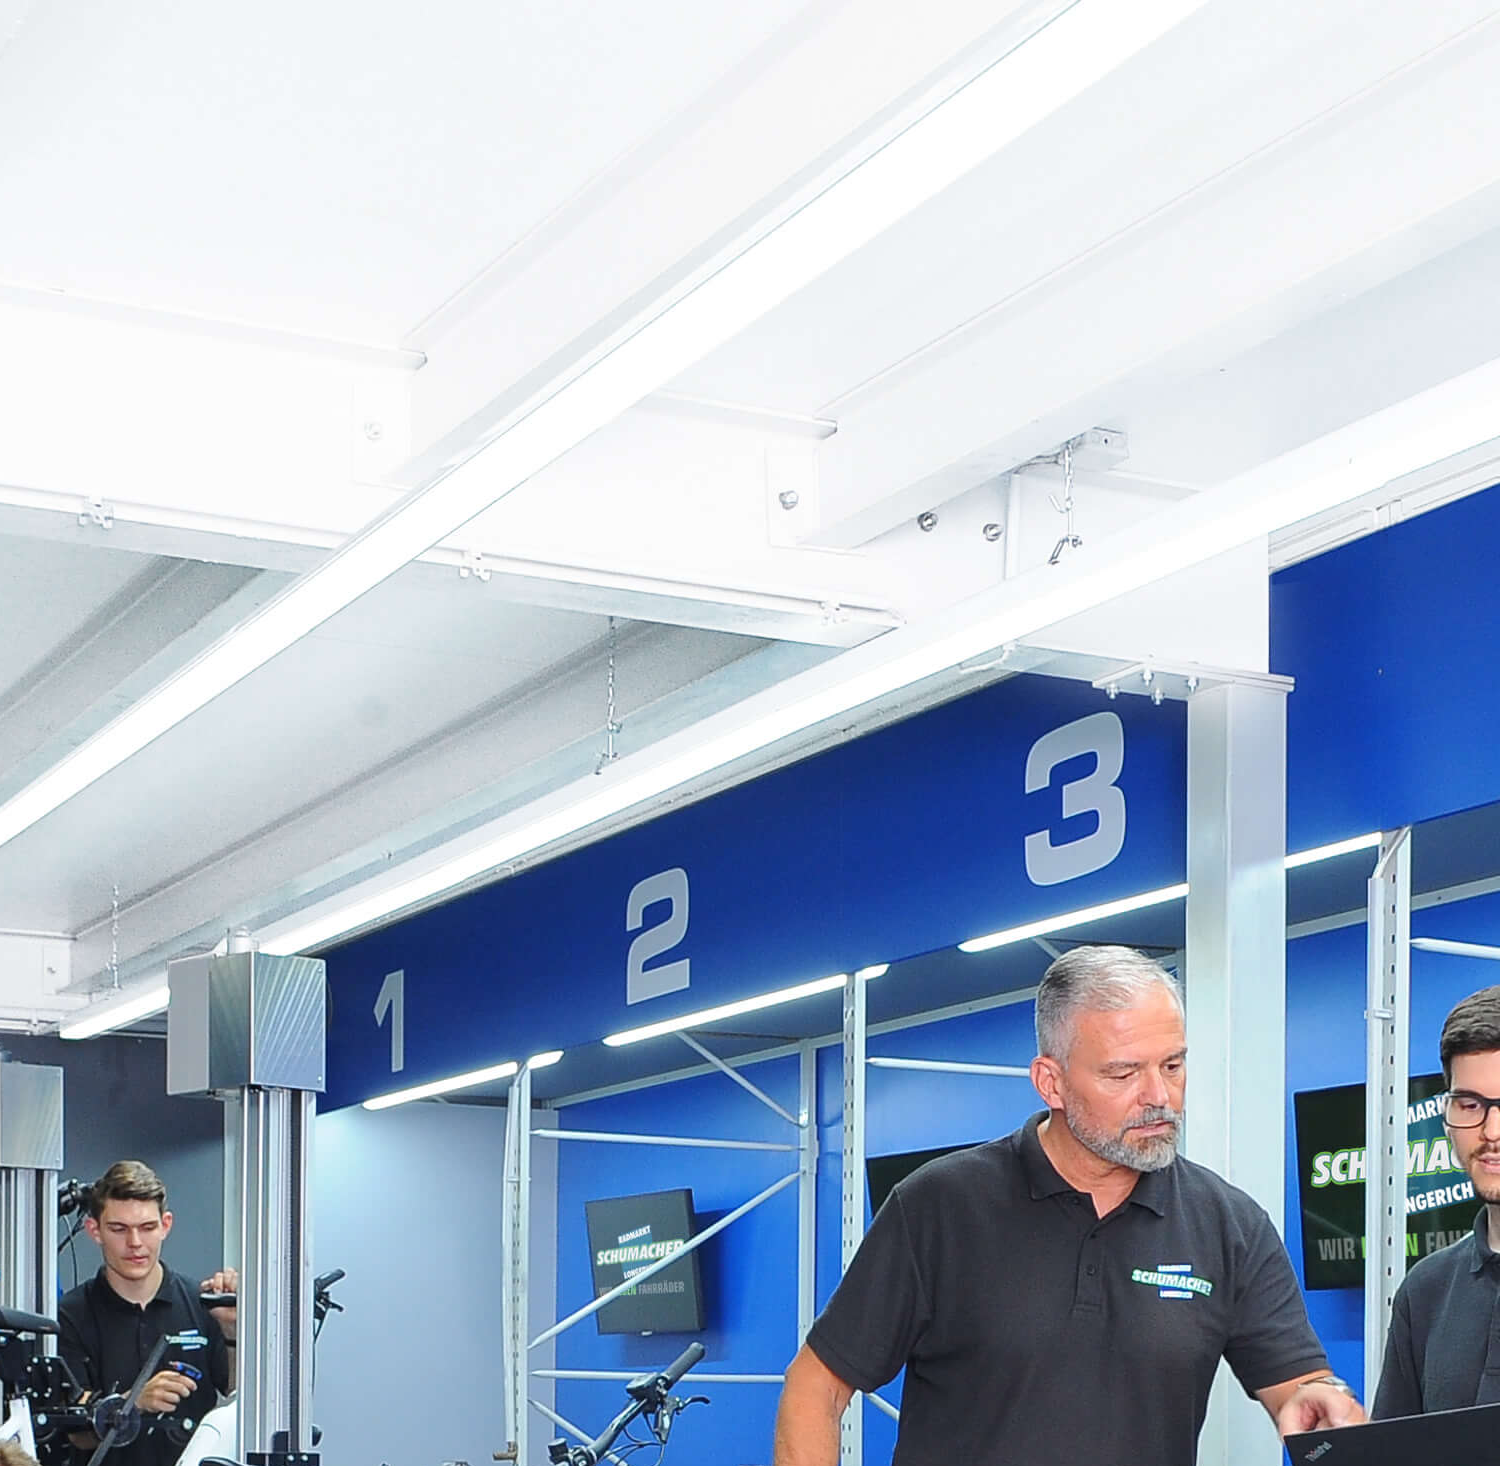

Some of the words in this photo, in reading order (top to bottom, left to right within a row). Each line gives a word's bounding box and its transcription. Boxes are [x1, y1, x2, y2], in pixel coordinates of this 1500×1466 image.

[1024, 711, 1126, 887] 3
[626, 867, 690, 1005] 2
[373, 968, 405, 1073] 1
[1317, 1236, 1356, 1261] WIR
[1406, 1181, 1475, 1214] NGERICH
